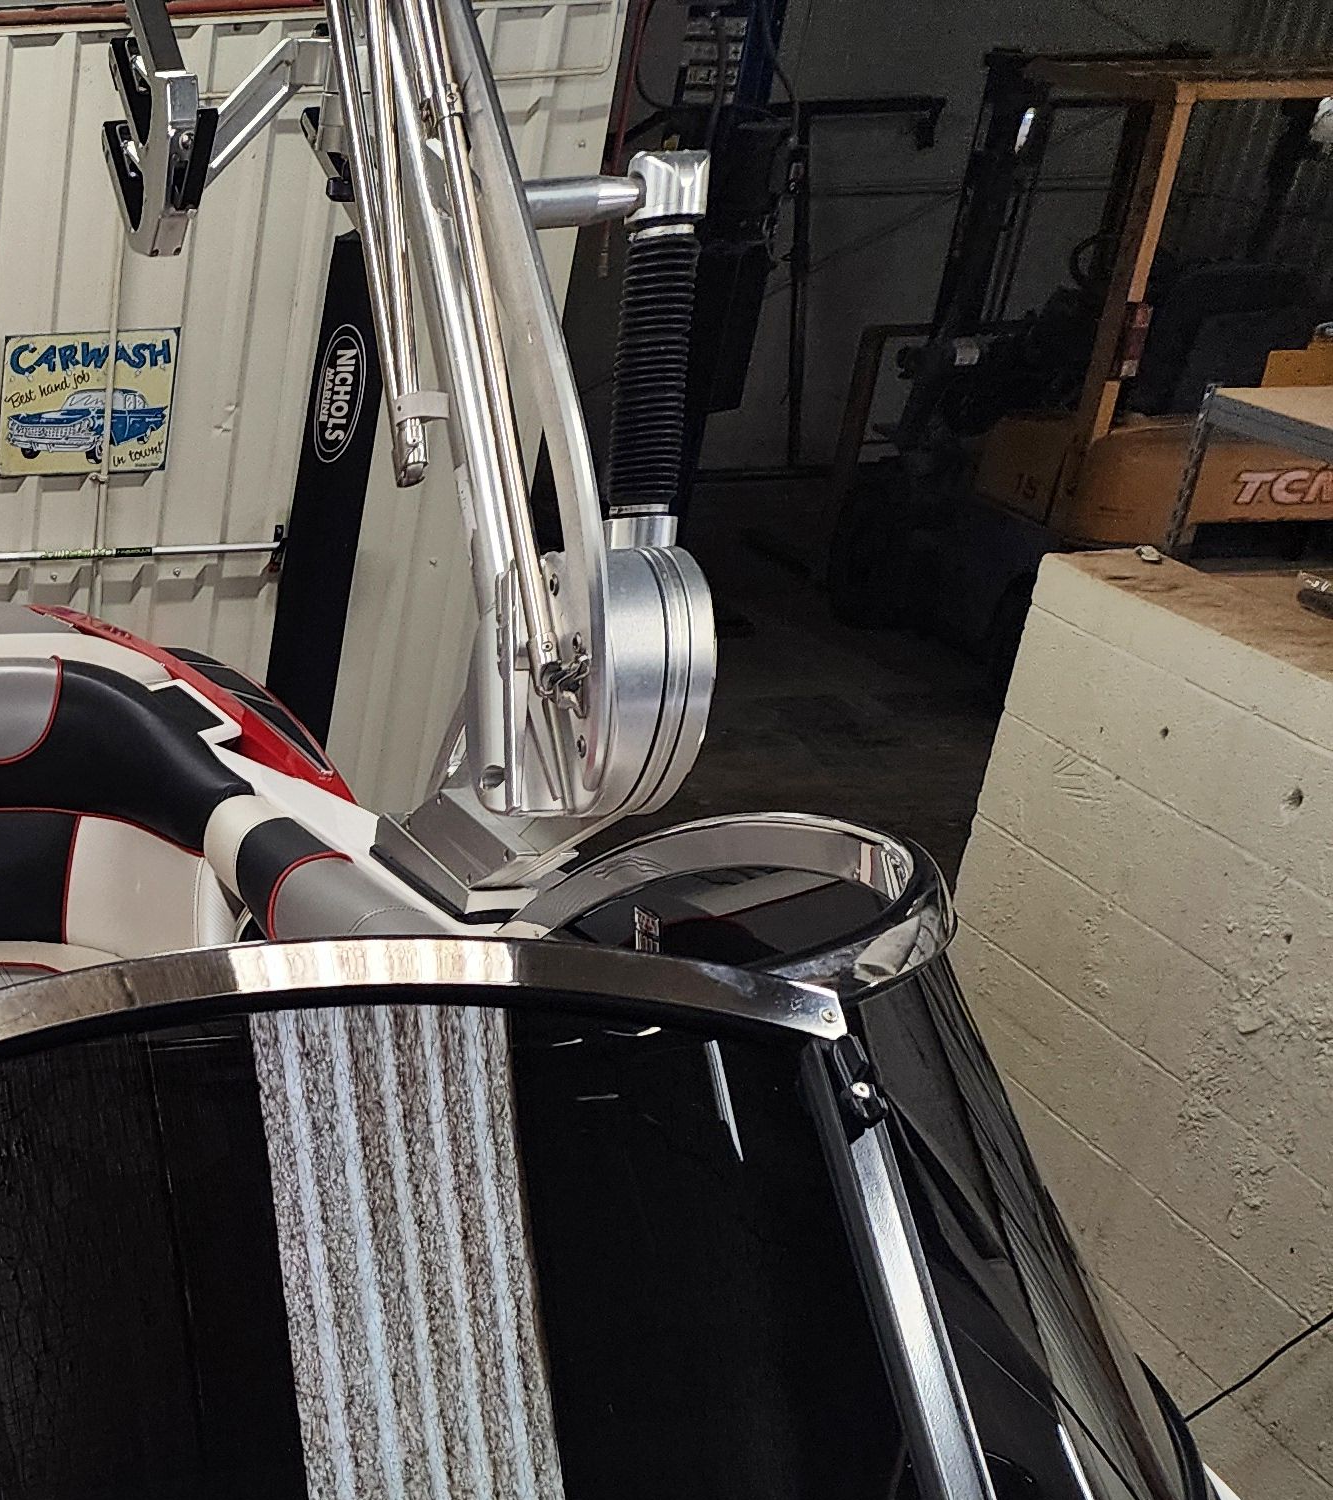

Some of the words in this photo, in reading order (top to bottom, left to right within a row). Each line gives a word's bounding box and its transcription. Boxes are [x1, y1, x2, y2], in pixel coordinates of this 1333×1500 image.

[10, 339, 172, 375] CARWASH
[4, 389, 37, 409] Best
[38, 376, 71, 398] hand
[72, 369, 91, 390] job
[318, 366, 335, 422] MARINE
[324, 348, 358, 441] NICHOLS
